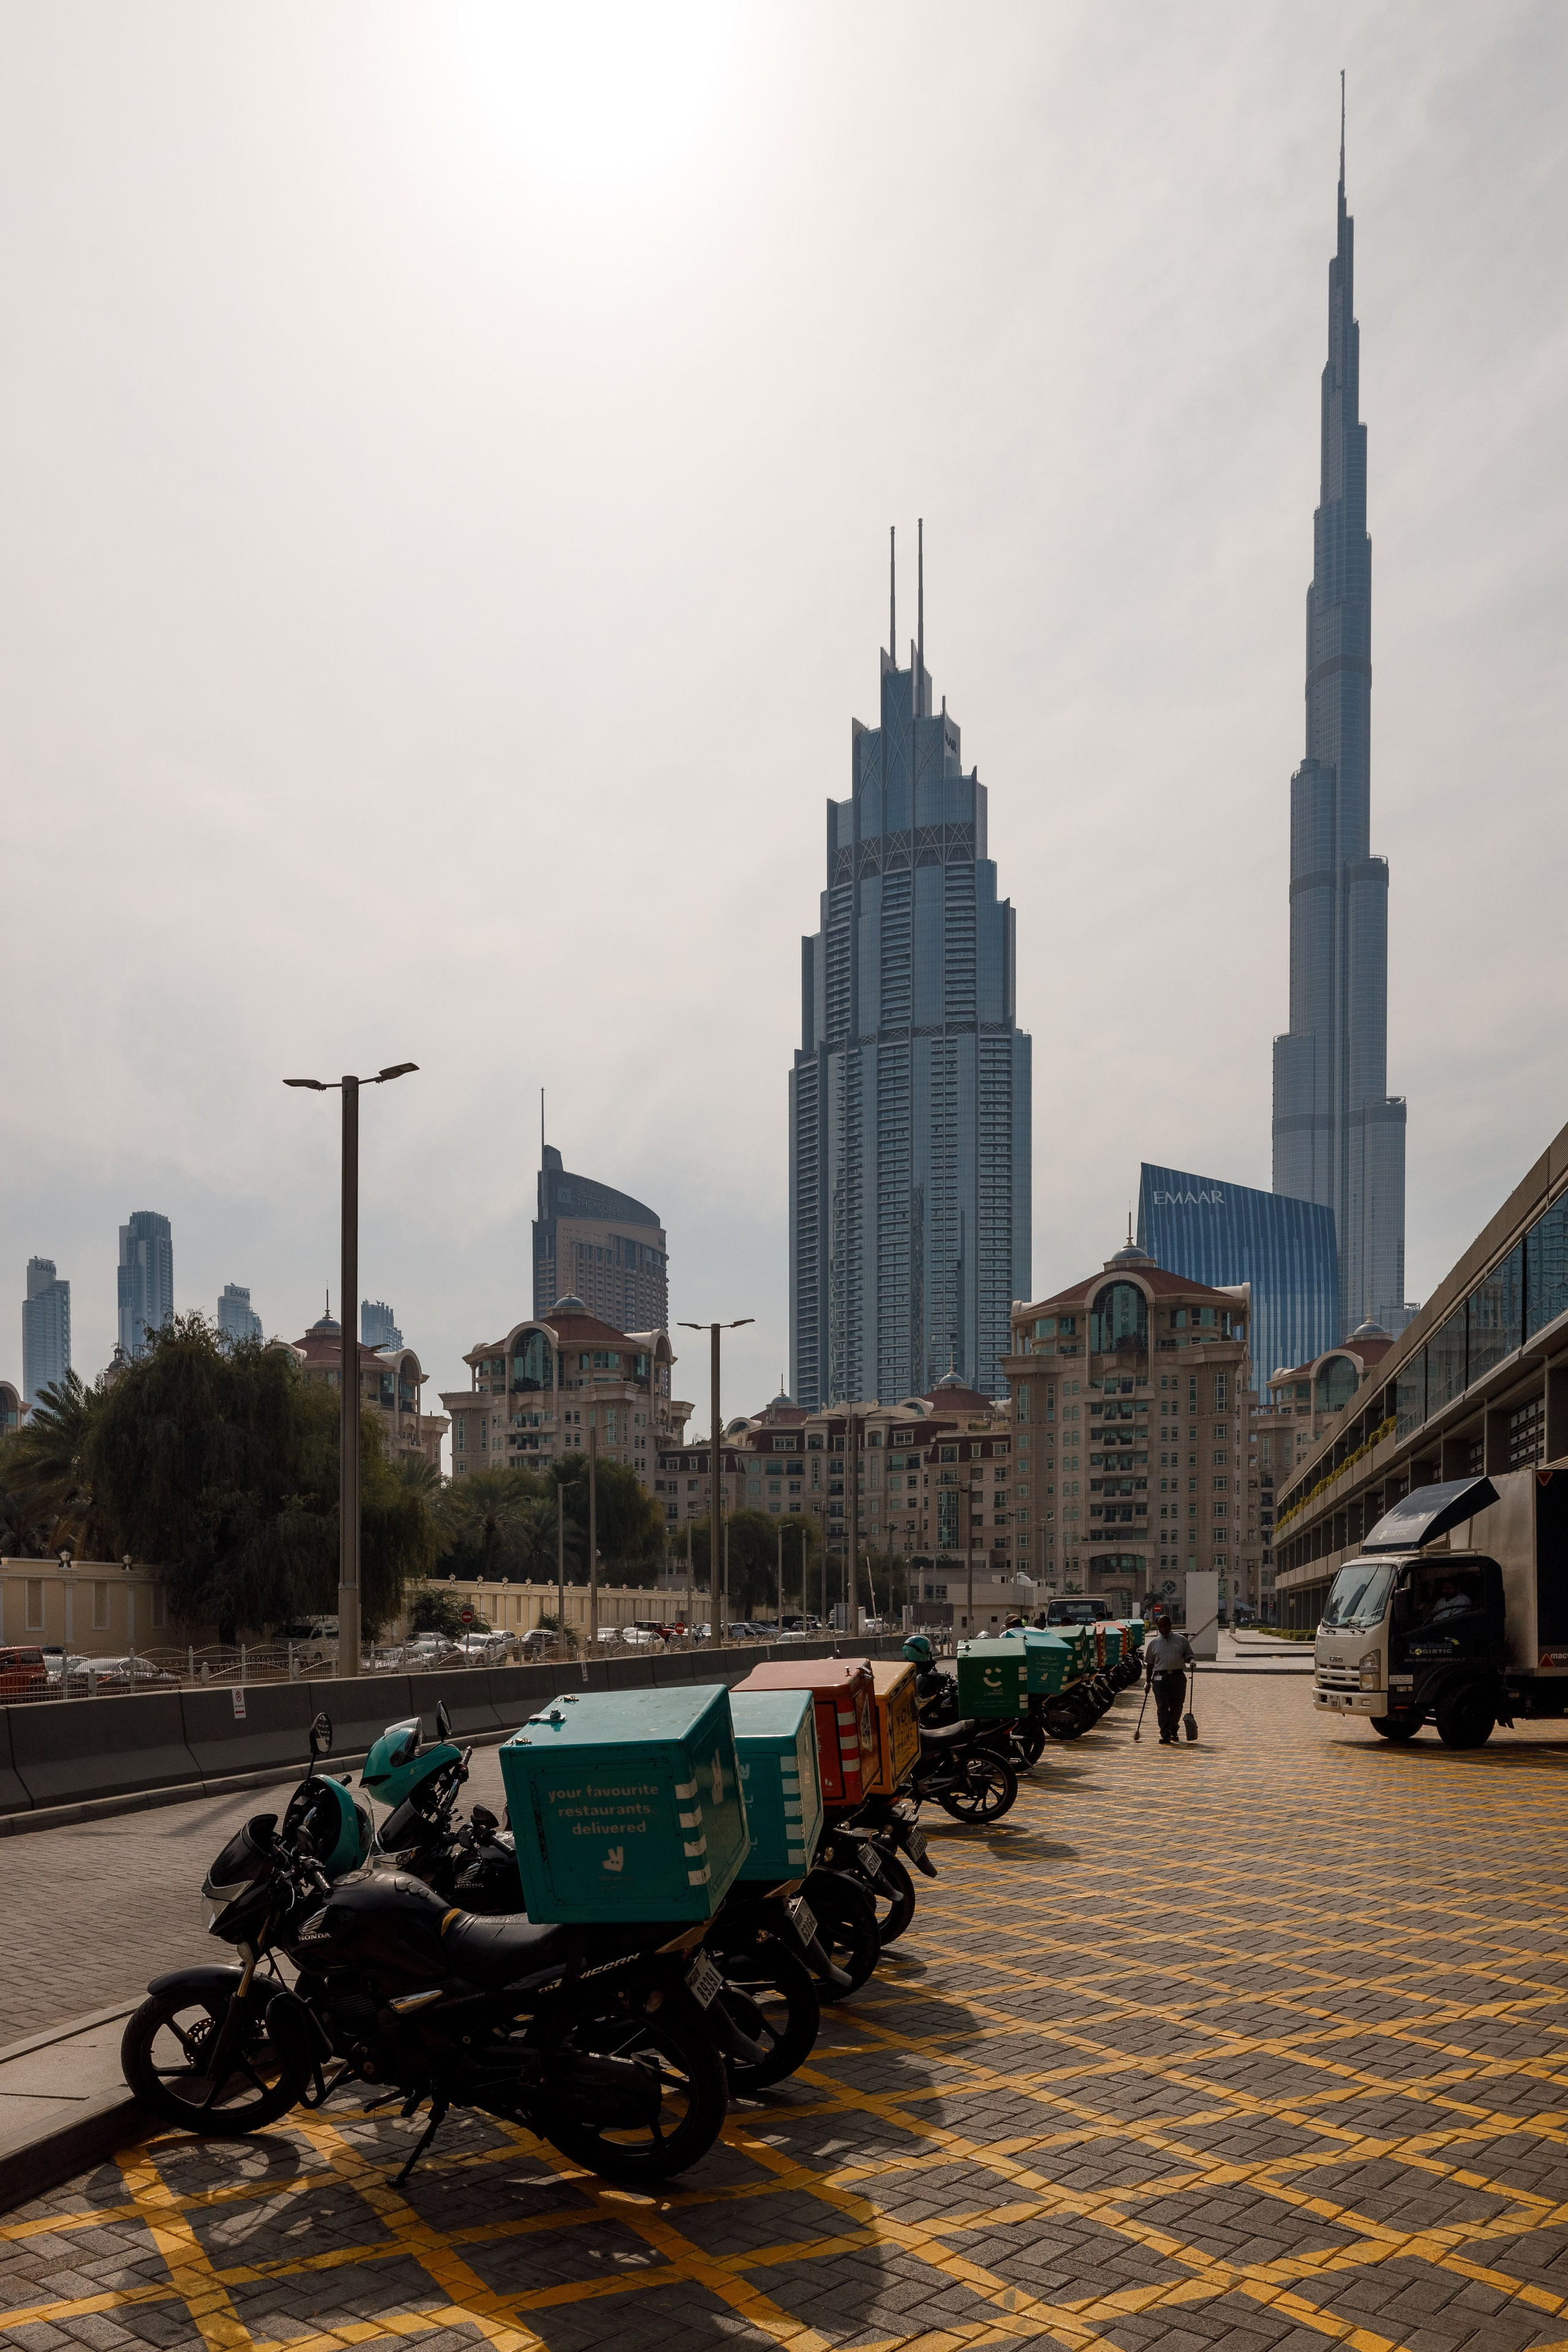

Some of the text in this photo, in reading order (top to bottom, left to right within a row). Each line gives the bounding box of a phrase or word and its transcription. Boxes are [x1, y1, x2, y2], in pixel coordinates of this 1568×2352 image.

[1153, 1190, 1225, 1205] EMAAR
[36, 1262, 56, 1275] EMAA
[230, 1289, 251, 1301] EMAA
[548, 1782, 660, 1804] your favourite
[571, 1819, 647, 1835] delivered
[298, 1932, 332, 1941] HONDA
[696, 1967, 720, 2002] 89391
